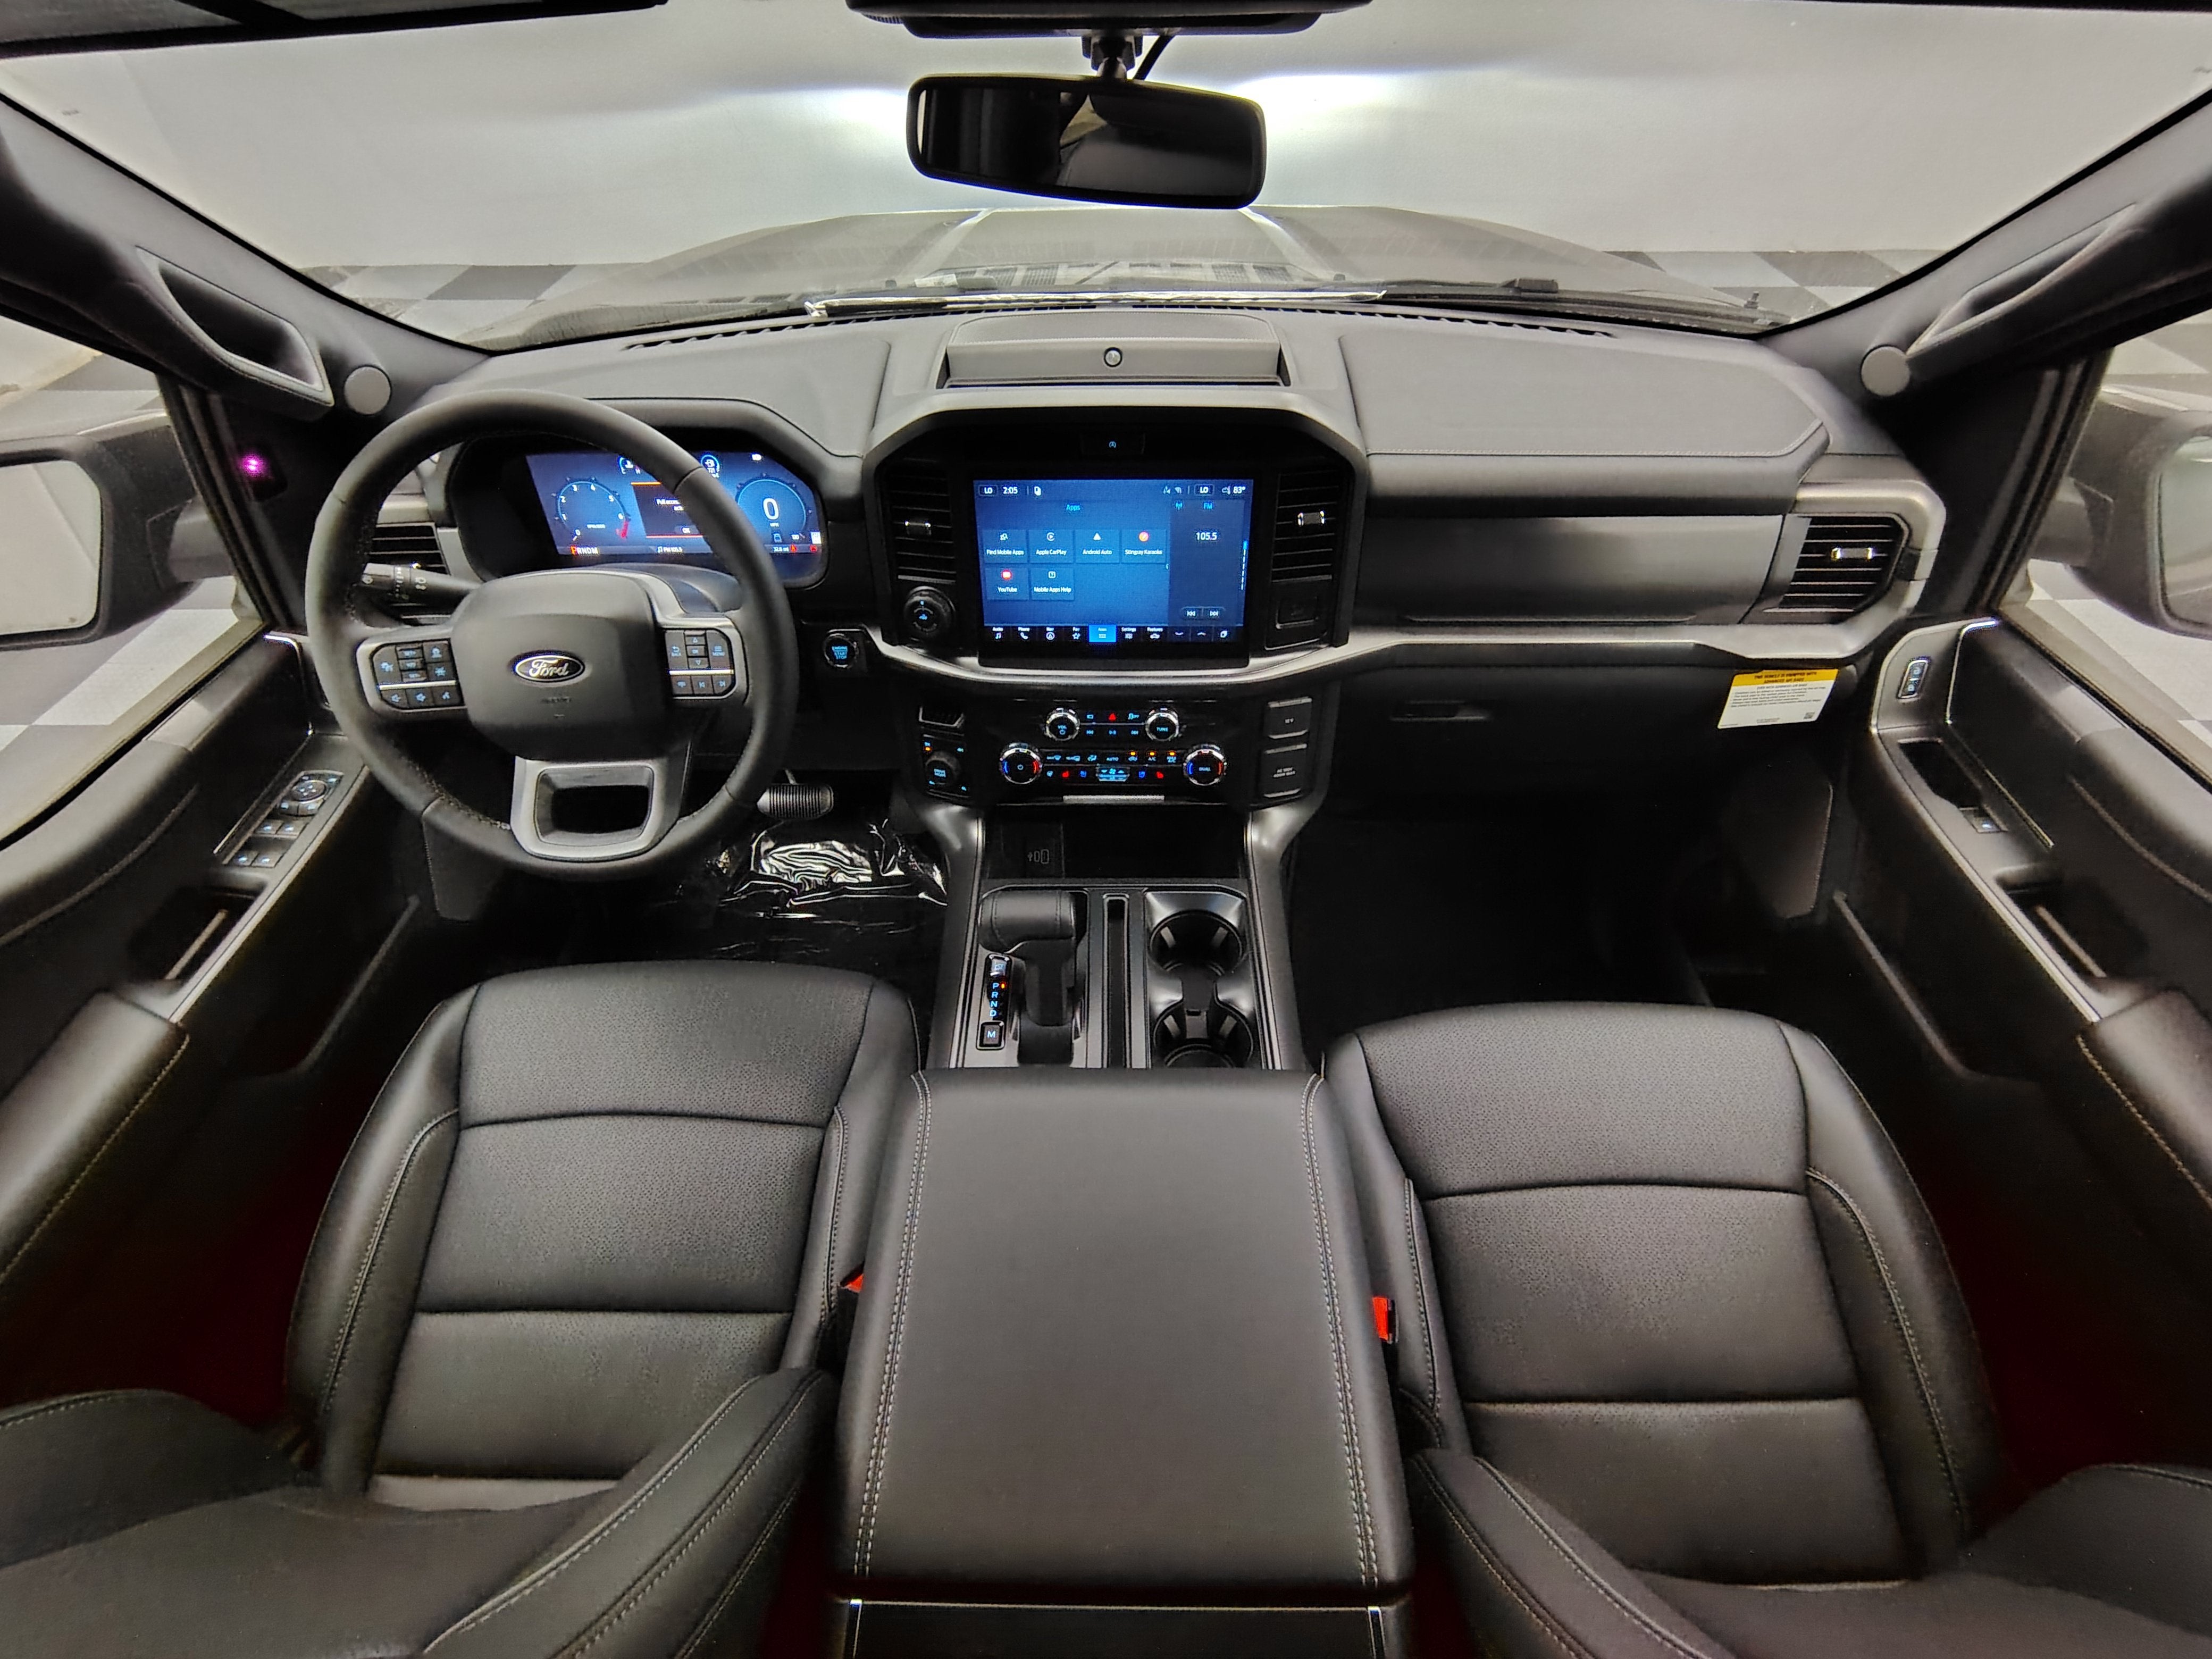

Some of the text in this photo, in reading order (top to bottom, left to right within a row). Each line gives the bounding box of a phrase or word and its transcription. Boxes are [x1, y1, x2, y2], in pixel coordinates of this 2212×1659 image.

[1003, 486, 1018, 495] 2:05
[763, 498, 779, 520] 0
[1196, 532, 1217, 540] 105.5
[529, 659, 569, 677] Ford
